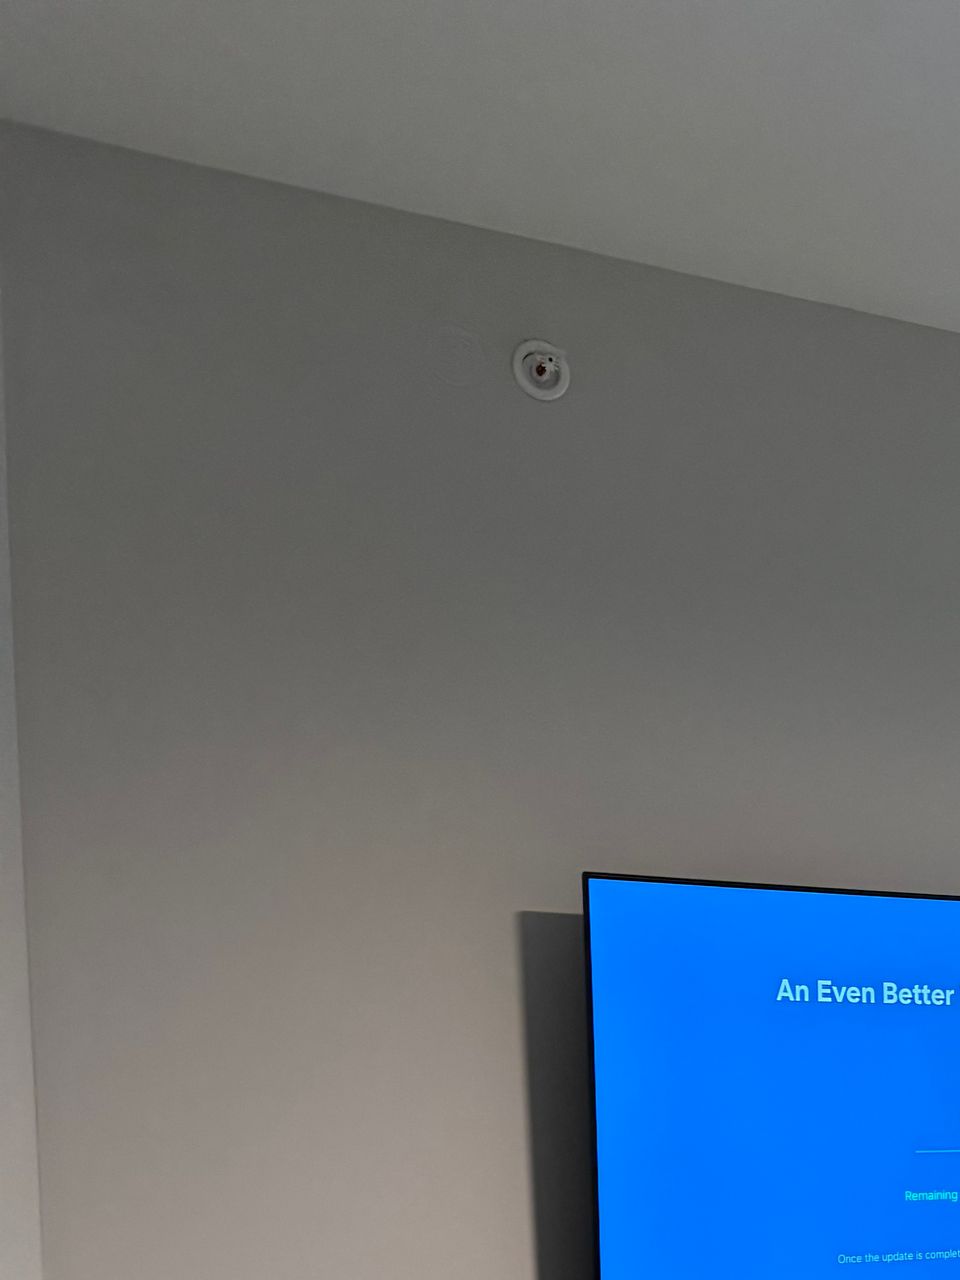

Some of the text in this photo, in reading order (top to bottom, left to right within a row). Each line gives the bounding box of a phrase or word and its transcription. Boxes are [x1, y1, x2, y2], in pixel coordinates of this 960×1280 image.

[776, 979, 809, 1001] An
[817, 980, 875, 1003] Even
[883, 982, 954, 1006] Better
[905, 1189, 958, 1202] Remaining
[837, 1253, 862, 1264] Once
[864, 1252, 880, 1263] the
[881, 1251, 914, 1263] update
[915, 1250, 923, 1260] is
